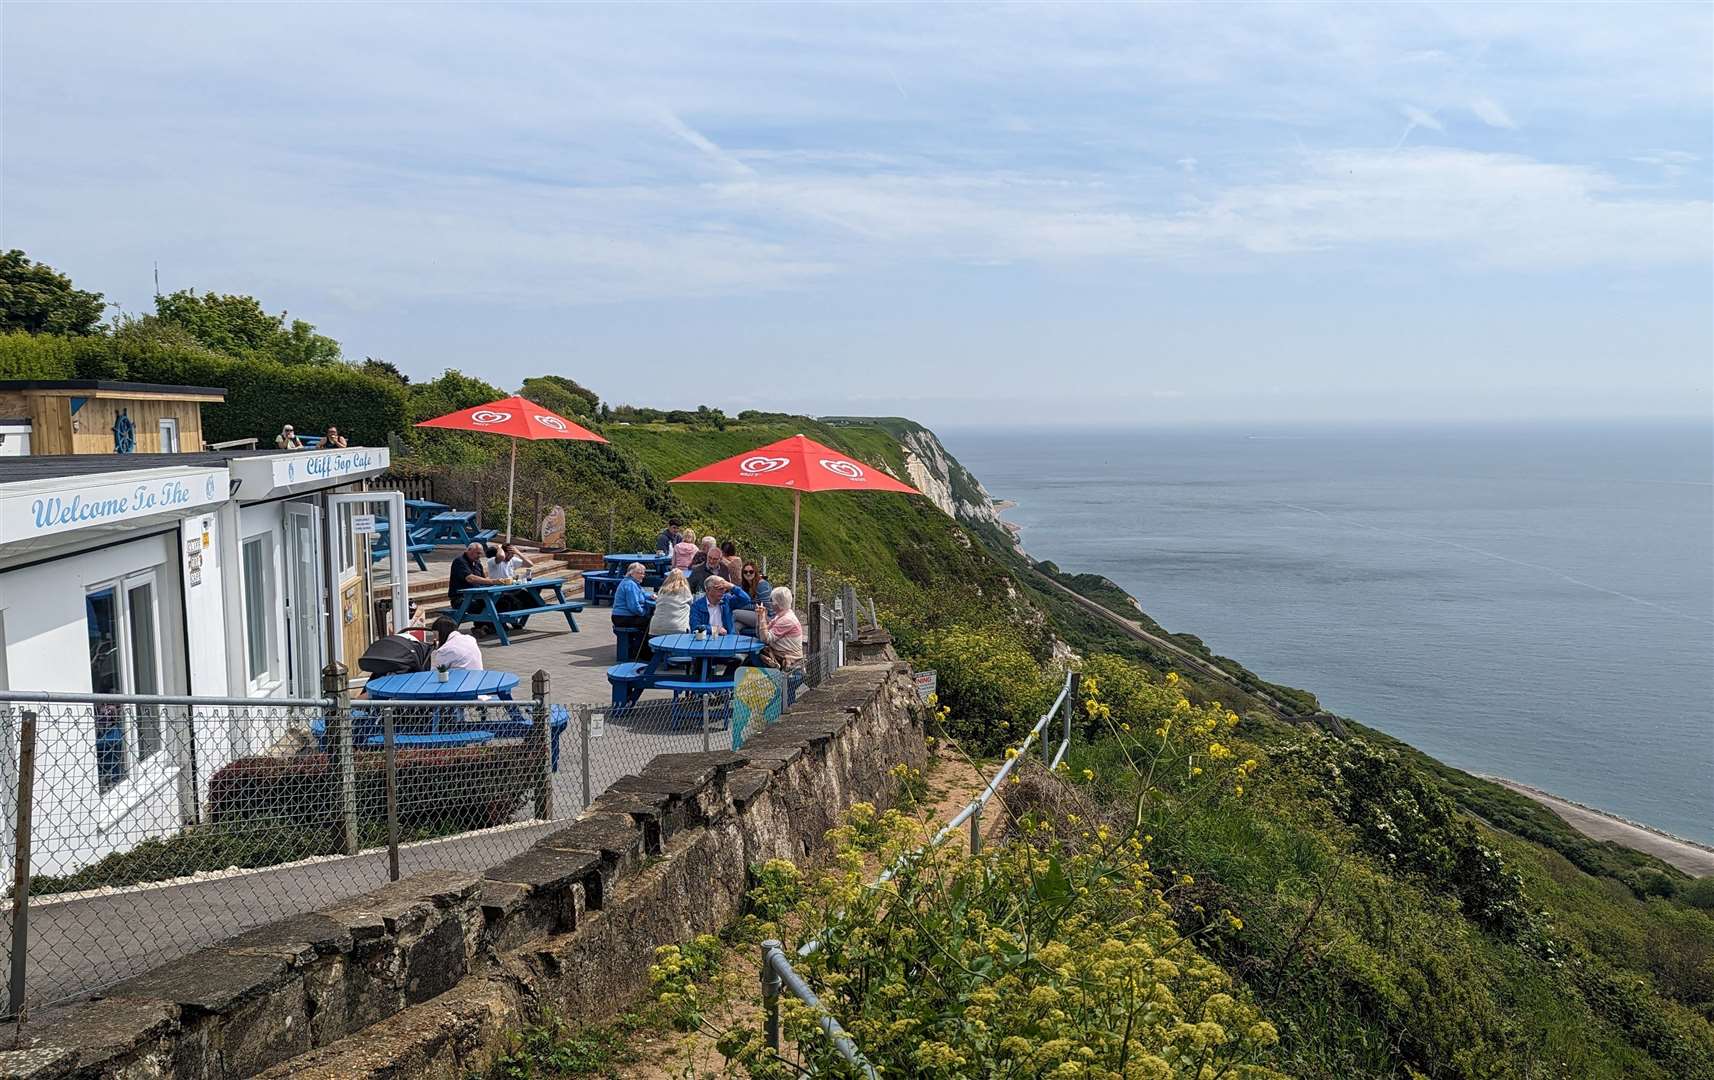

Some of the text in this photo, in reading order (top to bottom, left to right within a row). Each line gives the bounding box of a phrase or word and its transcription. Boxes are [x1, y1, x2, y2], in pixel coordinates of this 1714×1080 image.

[306, 455, 331, 477] Cliff
[334, 454, 351, 473] Top
[31, 480, 190, 528] Welcome To The
